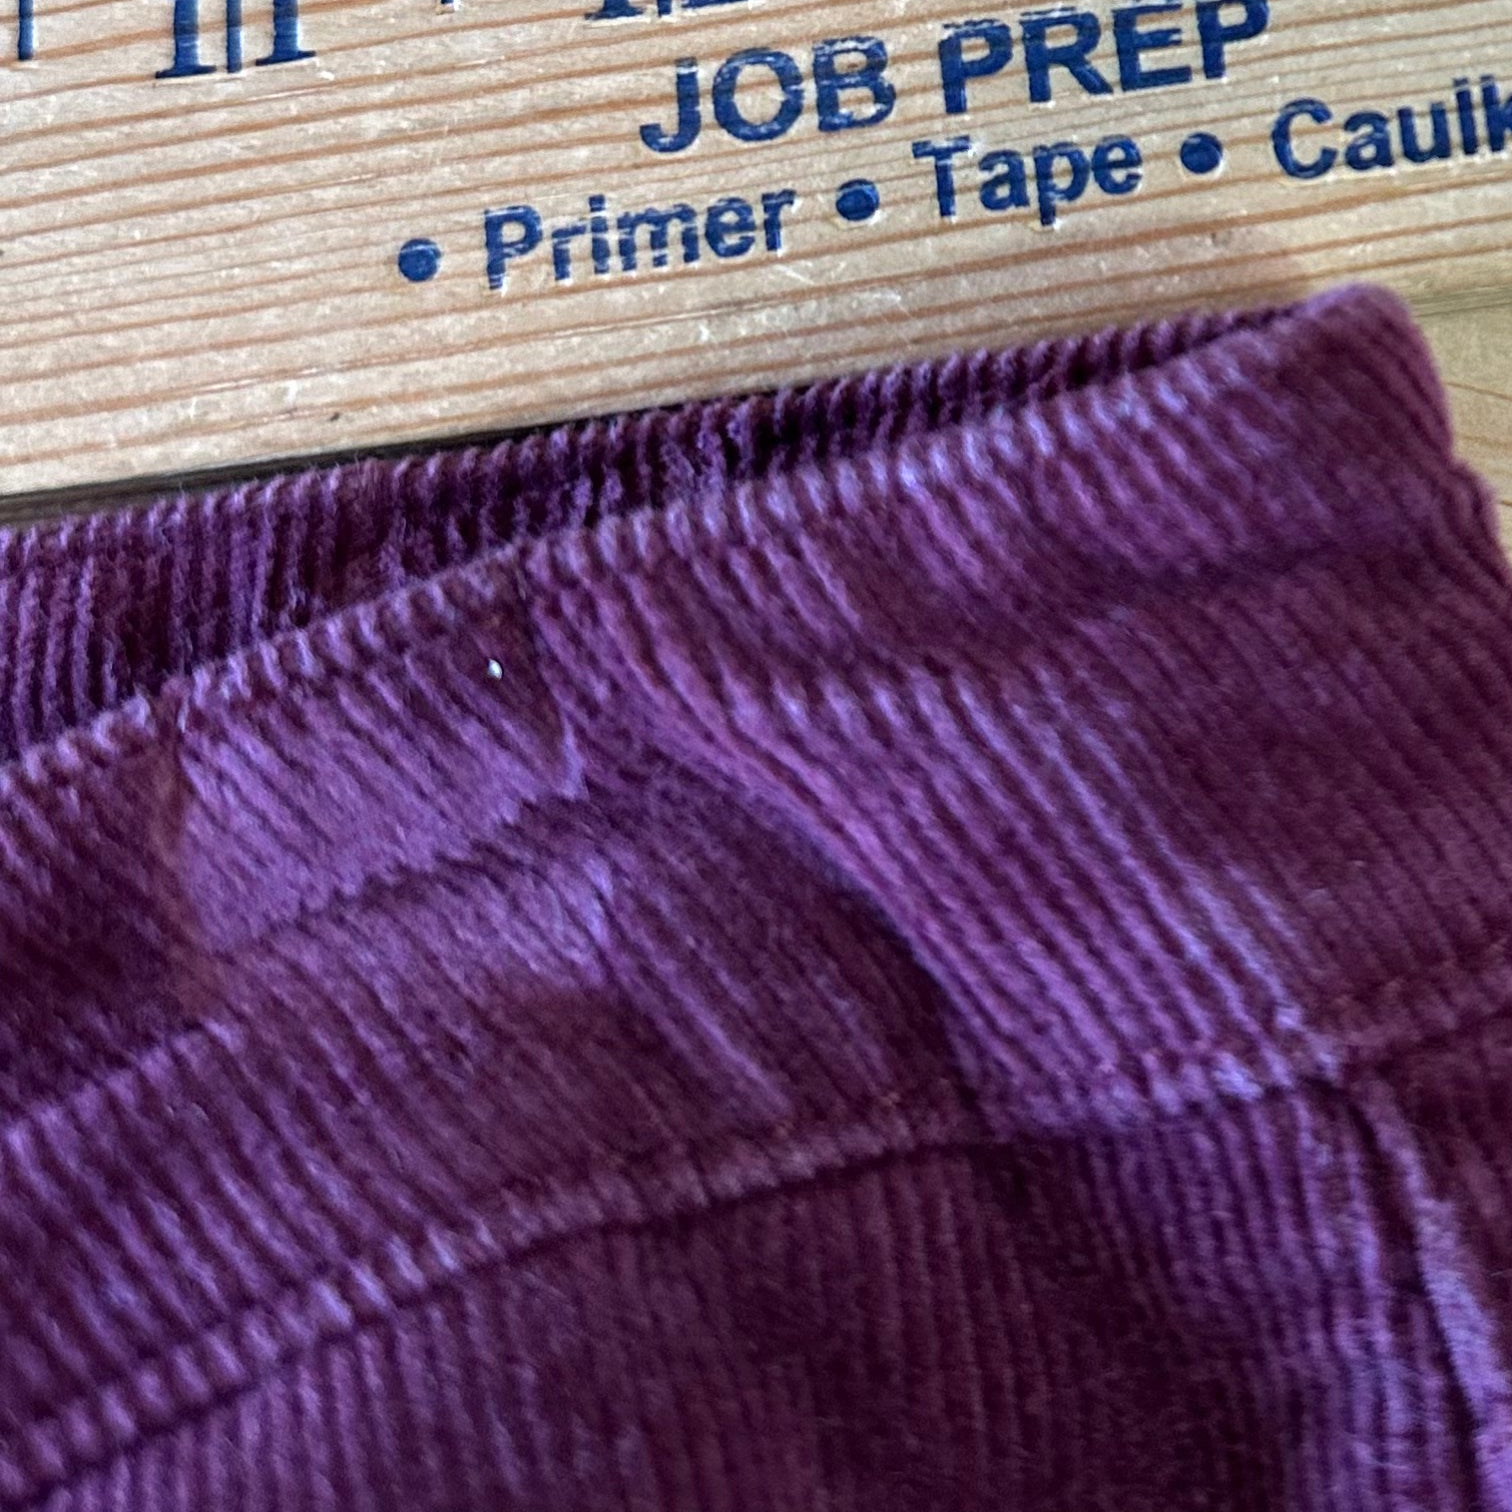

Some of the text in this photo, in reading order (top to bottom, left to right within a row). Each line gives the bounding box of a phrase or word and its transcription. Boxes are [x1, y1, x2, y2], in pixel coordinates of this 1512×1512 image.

[640, 36, 897, 154] JOB
[483, 189, 797, 291] Primer
[911, 133, 1143, 228] Tape
